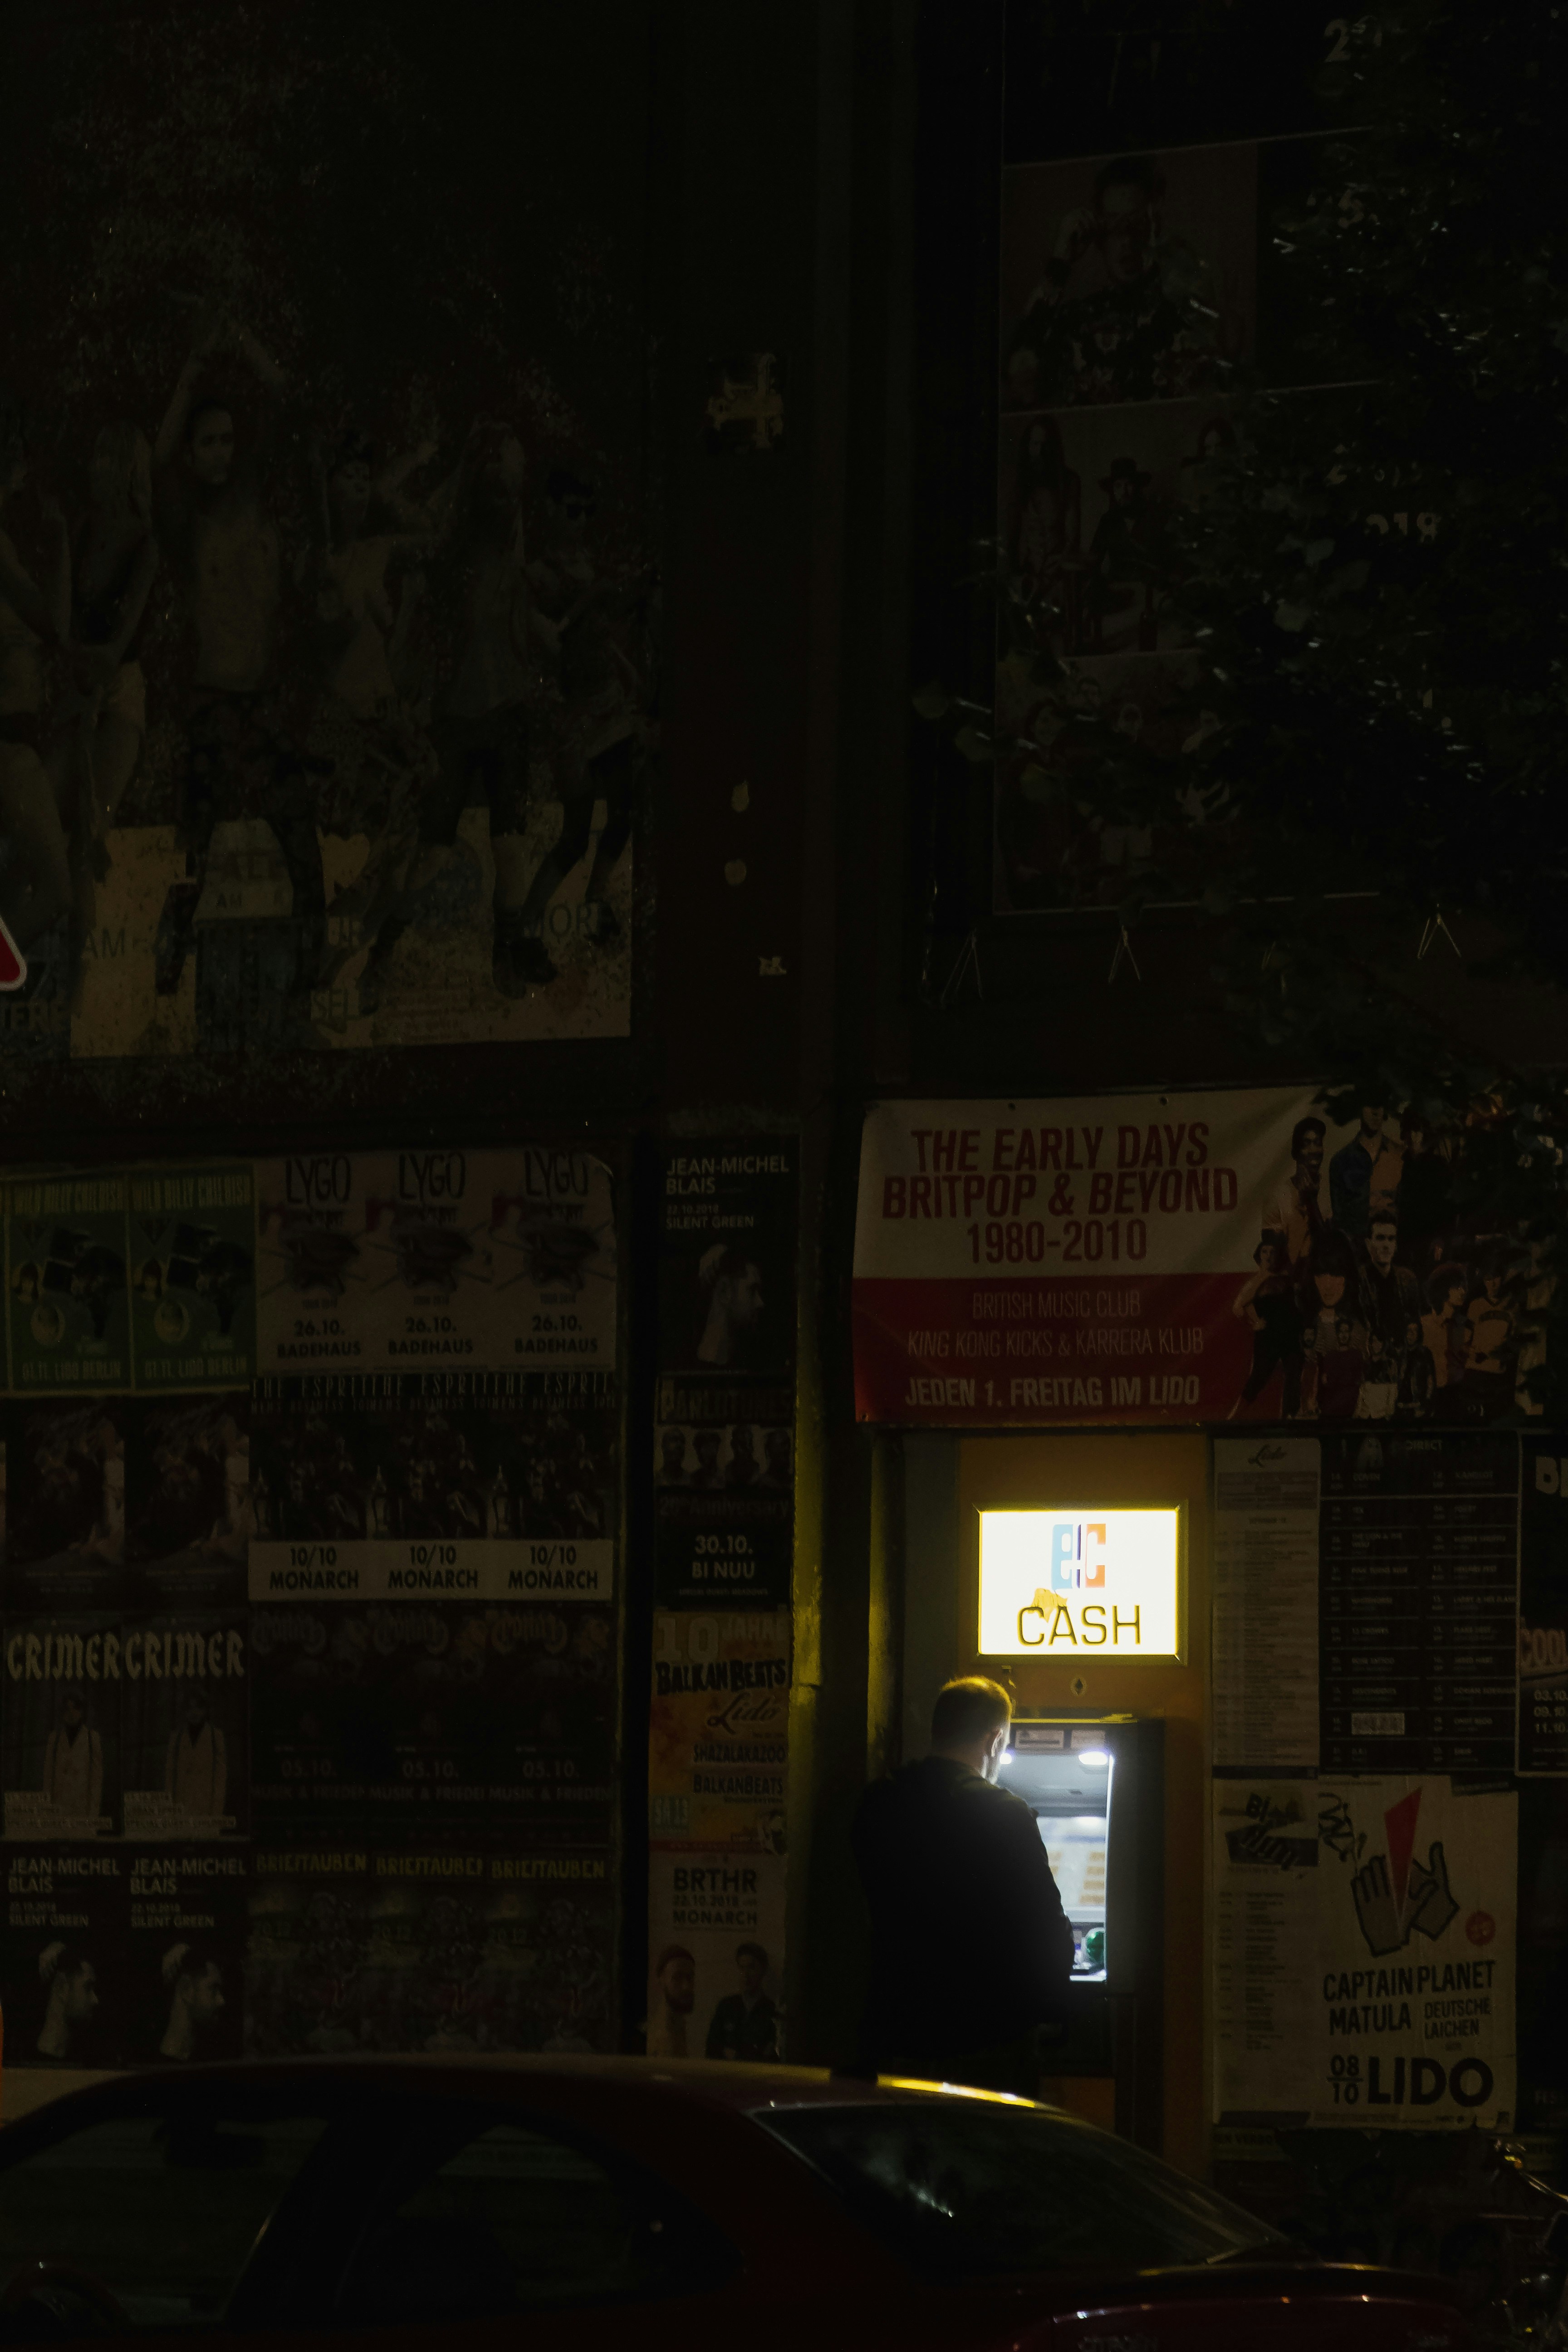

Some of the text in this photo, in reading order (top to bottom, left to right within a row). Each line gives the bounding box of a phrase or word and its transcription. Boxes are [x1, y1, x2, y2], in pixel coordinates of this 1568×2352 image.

[911, 1122, 1210, 1172] THE EARLY DAYS
[523, 1149, 589, 1201] LYGO
[666, 1155, 789, 1176] JEAN-MICHEL
[285, 1155, 351, 1205] LYGO
[398, 1152, 466, 1203] LYGO
[666, 1177, 716, 1196] BLAIS
[882, 1168, 1238, 1219] BRITPOP & BEYOND
[666, 1215, 755, 1230] SILENT GREEN
[967, 1219, 1147, 1263] 1980-2010
[972, 1290, 1141, 1320] BRITISH MUSIC CLUB
[295, 1319, 345, 1338] 26.10.
[405, 1317, 457, 1334] 26.10.
[532, 1315, 583, 1333] 26.10.
[278, 1341, 361, 1358] BADEHAUS
[388, 1339, 473, 1356] BADEHAUS
[515, 1338, 598, 1354] BADEHAUS
[907, 1327, 1204, 1358] KING KONG KICKS & KARRERA KLUB
[905, 1375, 1200, 1408] JEDEN 1. FREITAG IM LIDO
[695, 1534, 754, 1555] 30.10.
[290, 1546, 337, 1573] 10/10
[409, 1544, 456, 1572] 10/10
[529, 1544, 577, 1571] 10/10
[270, 1569, 359, 1590] MONARCH
[388, 1568, 478, 1589] MONARCH
[508, 1568, 598, 1589] MONARCH
[691, 1559, 756, 1580] BI NUU
[1017, 1604, 1142, 1647] CASH
[656, 1616, 720, 1662] 10
[7, 1632, 121, 1681] CRIMER
[125, 1630, 245, 1681] CRIMER
[707, 1692, 782, 1735] Lido
[281, 1759, 337, 1779] 05.10.
[402, 1759, 459, 1779] 05.10.
[522, 1759, 580, 1779] 05.10.
[9, 1857, 121, 1876] JEAN-MICHEL
[130, 1857, 247, 1876] JEAN-MICHEL
[8, 1876, 54, 1894] BLAIS
[130, 1877, 178, 1895] BLAIS
[673, 1868, 757, 1893] BRTHR
[9, 1914, 89, 1927] SILENT GREEN
[131, 1915, 216, 1928] SILENT GREEN
[673, 1910, 757, 1925] MONARCH
[1323, 1960, 1495, 2002] CAPTAIN PLANET
[1329, 2002, 1411, 2036] MATULA
[1425, 1998, 1491, 2020] DEUTSCHE
[1425, 2019, 1480, 2039] LAICHEN
[1331, 2054, 1360, 2077] 08
[1367, 2056, 1494, 2107] LIDO
[1333, 2083, 1359, 2105] 10
